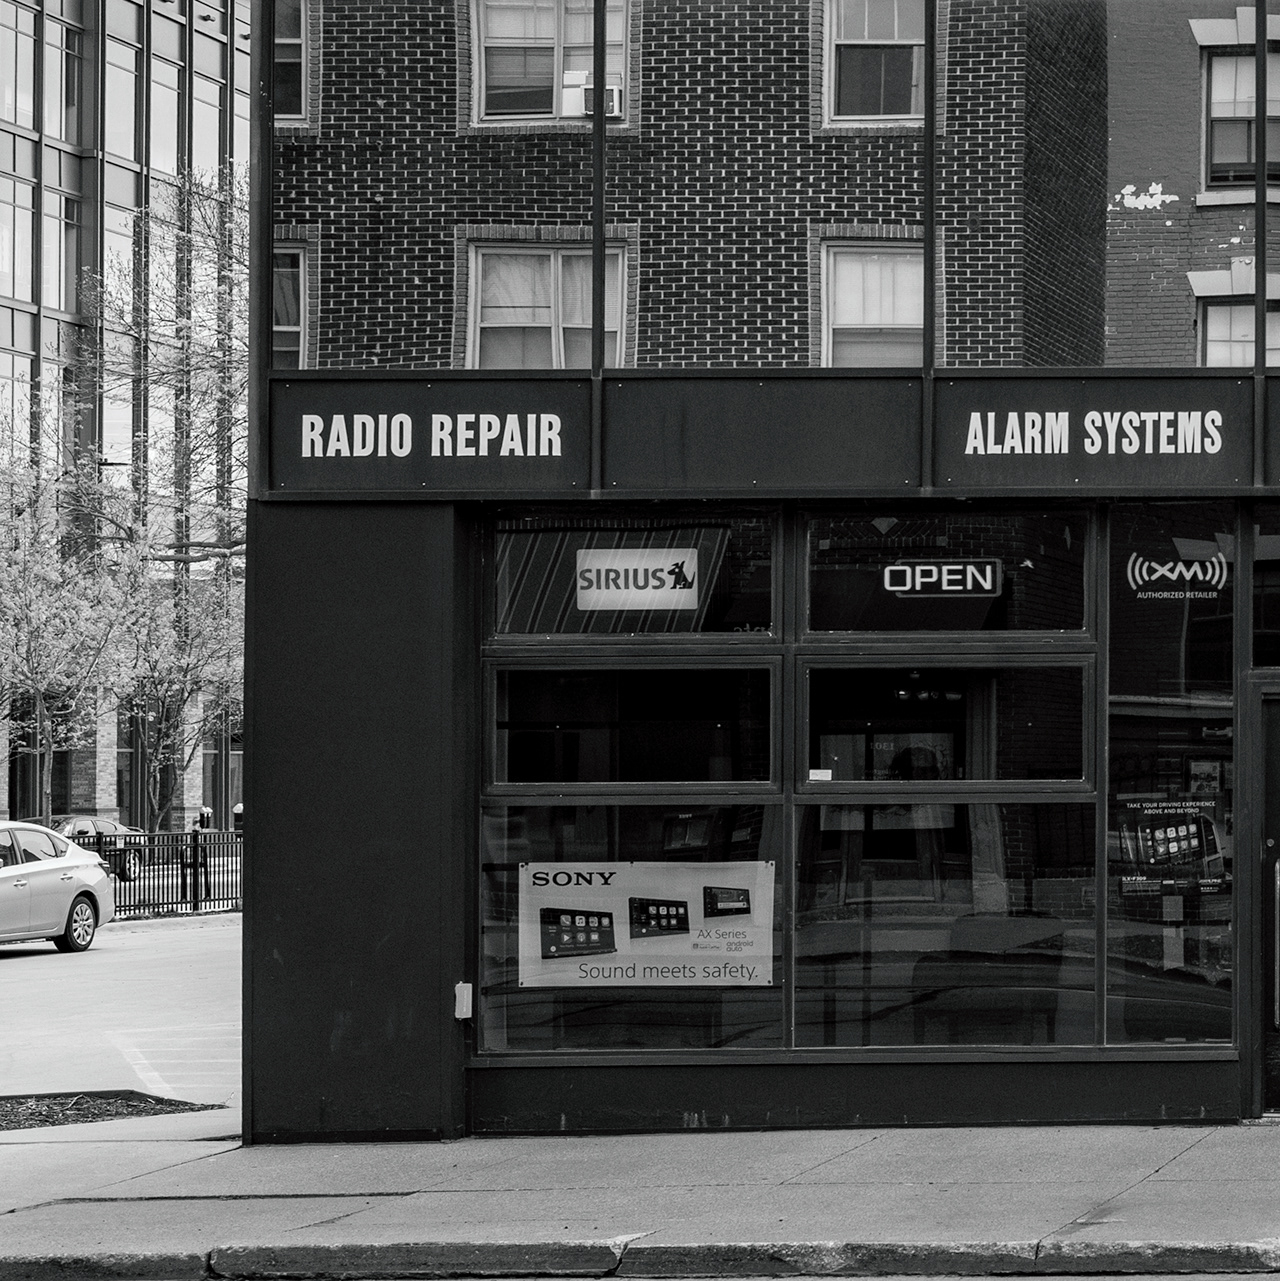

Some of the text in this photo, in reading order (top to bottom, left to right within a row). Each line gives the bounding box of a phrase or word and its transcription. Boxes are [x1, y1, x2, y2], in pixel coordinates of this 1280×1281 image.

[301, 414, 562, 458] RADIO REPAIR
[965, 410, 1223, 455] ALARM SYSTEMS
[579, 568, 665, 591] SIRIUS
[884, 565, 993, 592] OPEN
[1136, 591, 1218, 599] AUTHORIZED RETAILER
[532, 871, 616, 886] SONY
[697, 928, 747, 940] AX Series
[579, 962, 759, 980] Sound meets safety.
